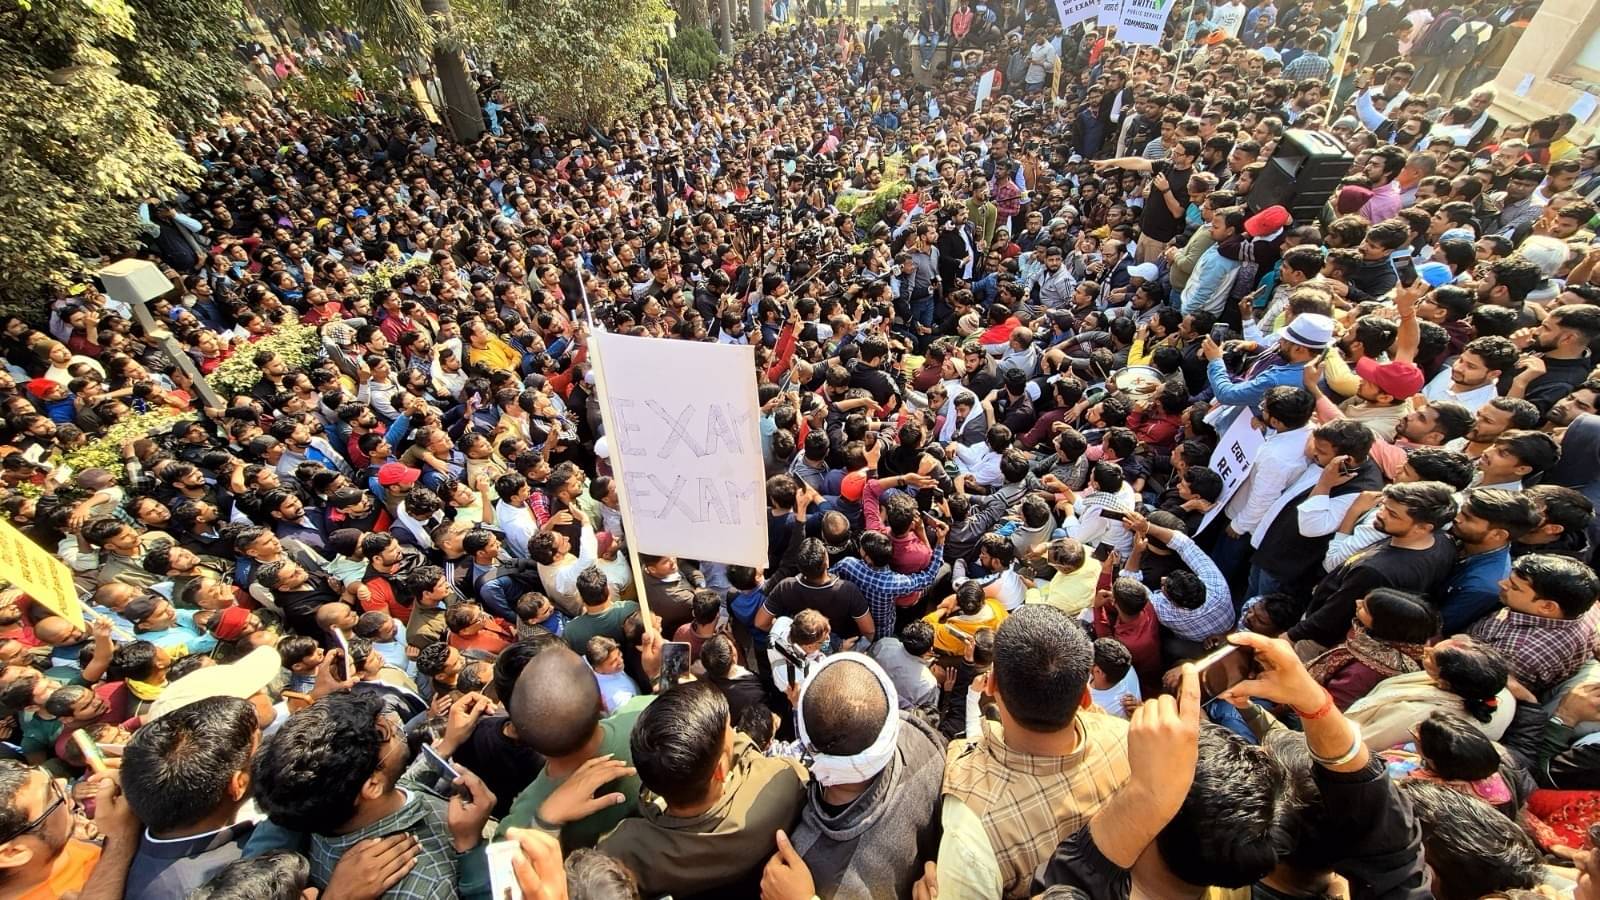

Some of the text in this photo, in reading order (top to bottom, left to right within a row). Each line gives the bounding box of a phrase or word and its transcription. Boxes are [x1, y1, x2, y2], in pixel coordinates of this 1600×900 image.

[1064, 6, 1074, 15] RE
[1075, 0, 1095, 11] EXAM
[1127, 8, 1163, 20] PUBLIC SERVICE
[1123, 18, 1159, 32] COMMISSION
[1216, 456, 1232, 481] RE
[624, 471, 761, 526] EXAM
